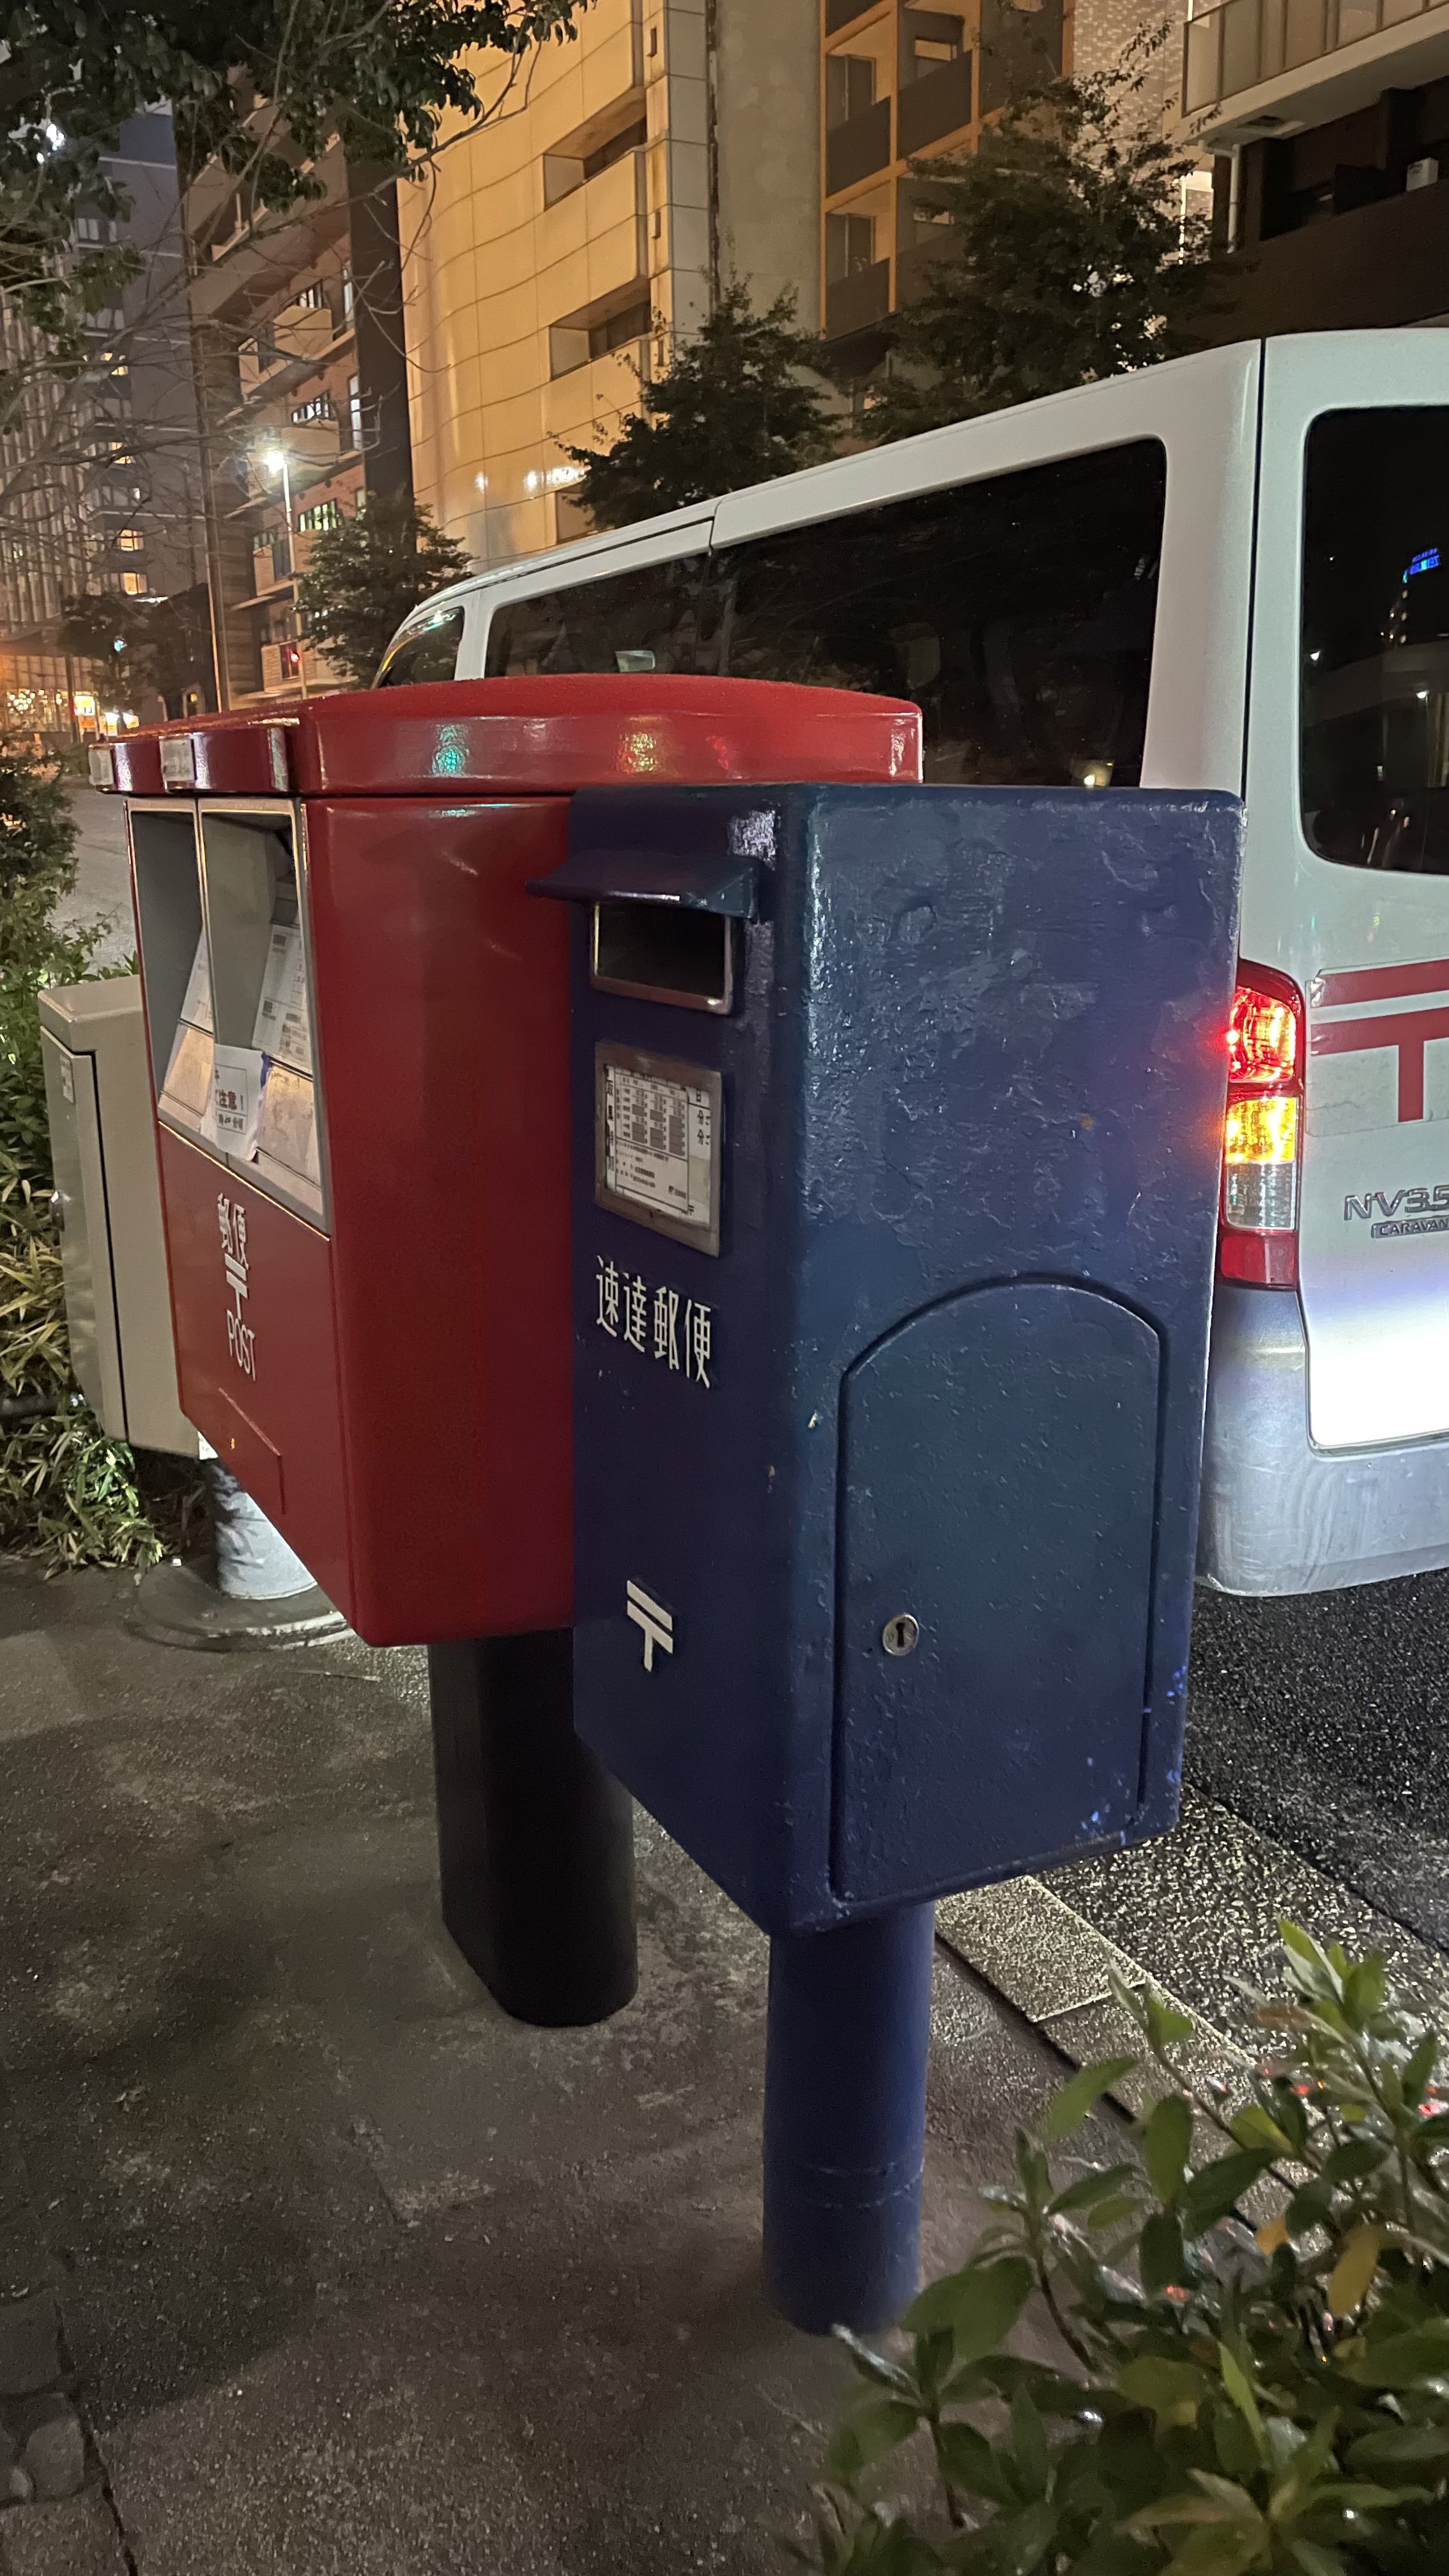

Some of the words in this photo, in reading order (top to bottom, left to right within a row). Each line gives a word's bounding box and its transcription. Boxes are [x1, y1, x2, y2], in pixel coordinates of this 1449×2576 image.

[218, 1193, 249, 1270] 郵便
[1380, 1218, 1449, 1236] CARAVAN
[227, 1309, 256, 1383] POST
[595, 1255, 711, 1388] 速達郵便
